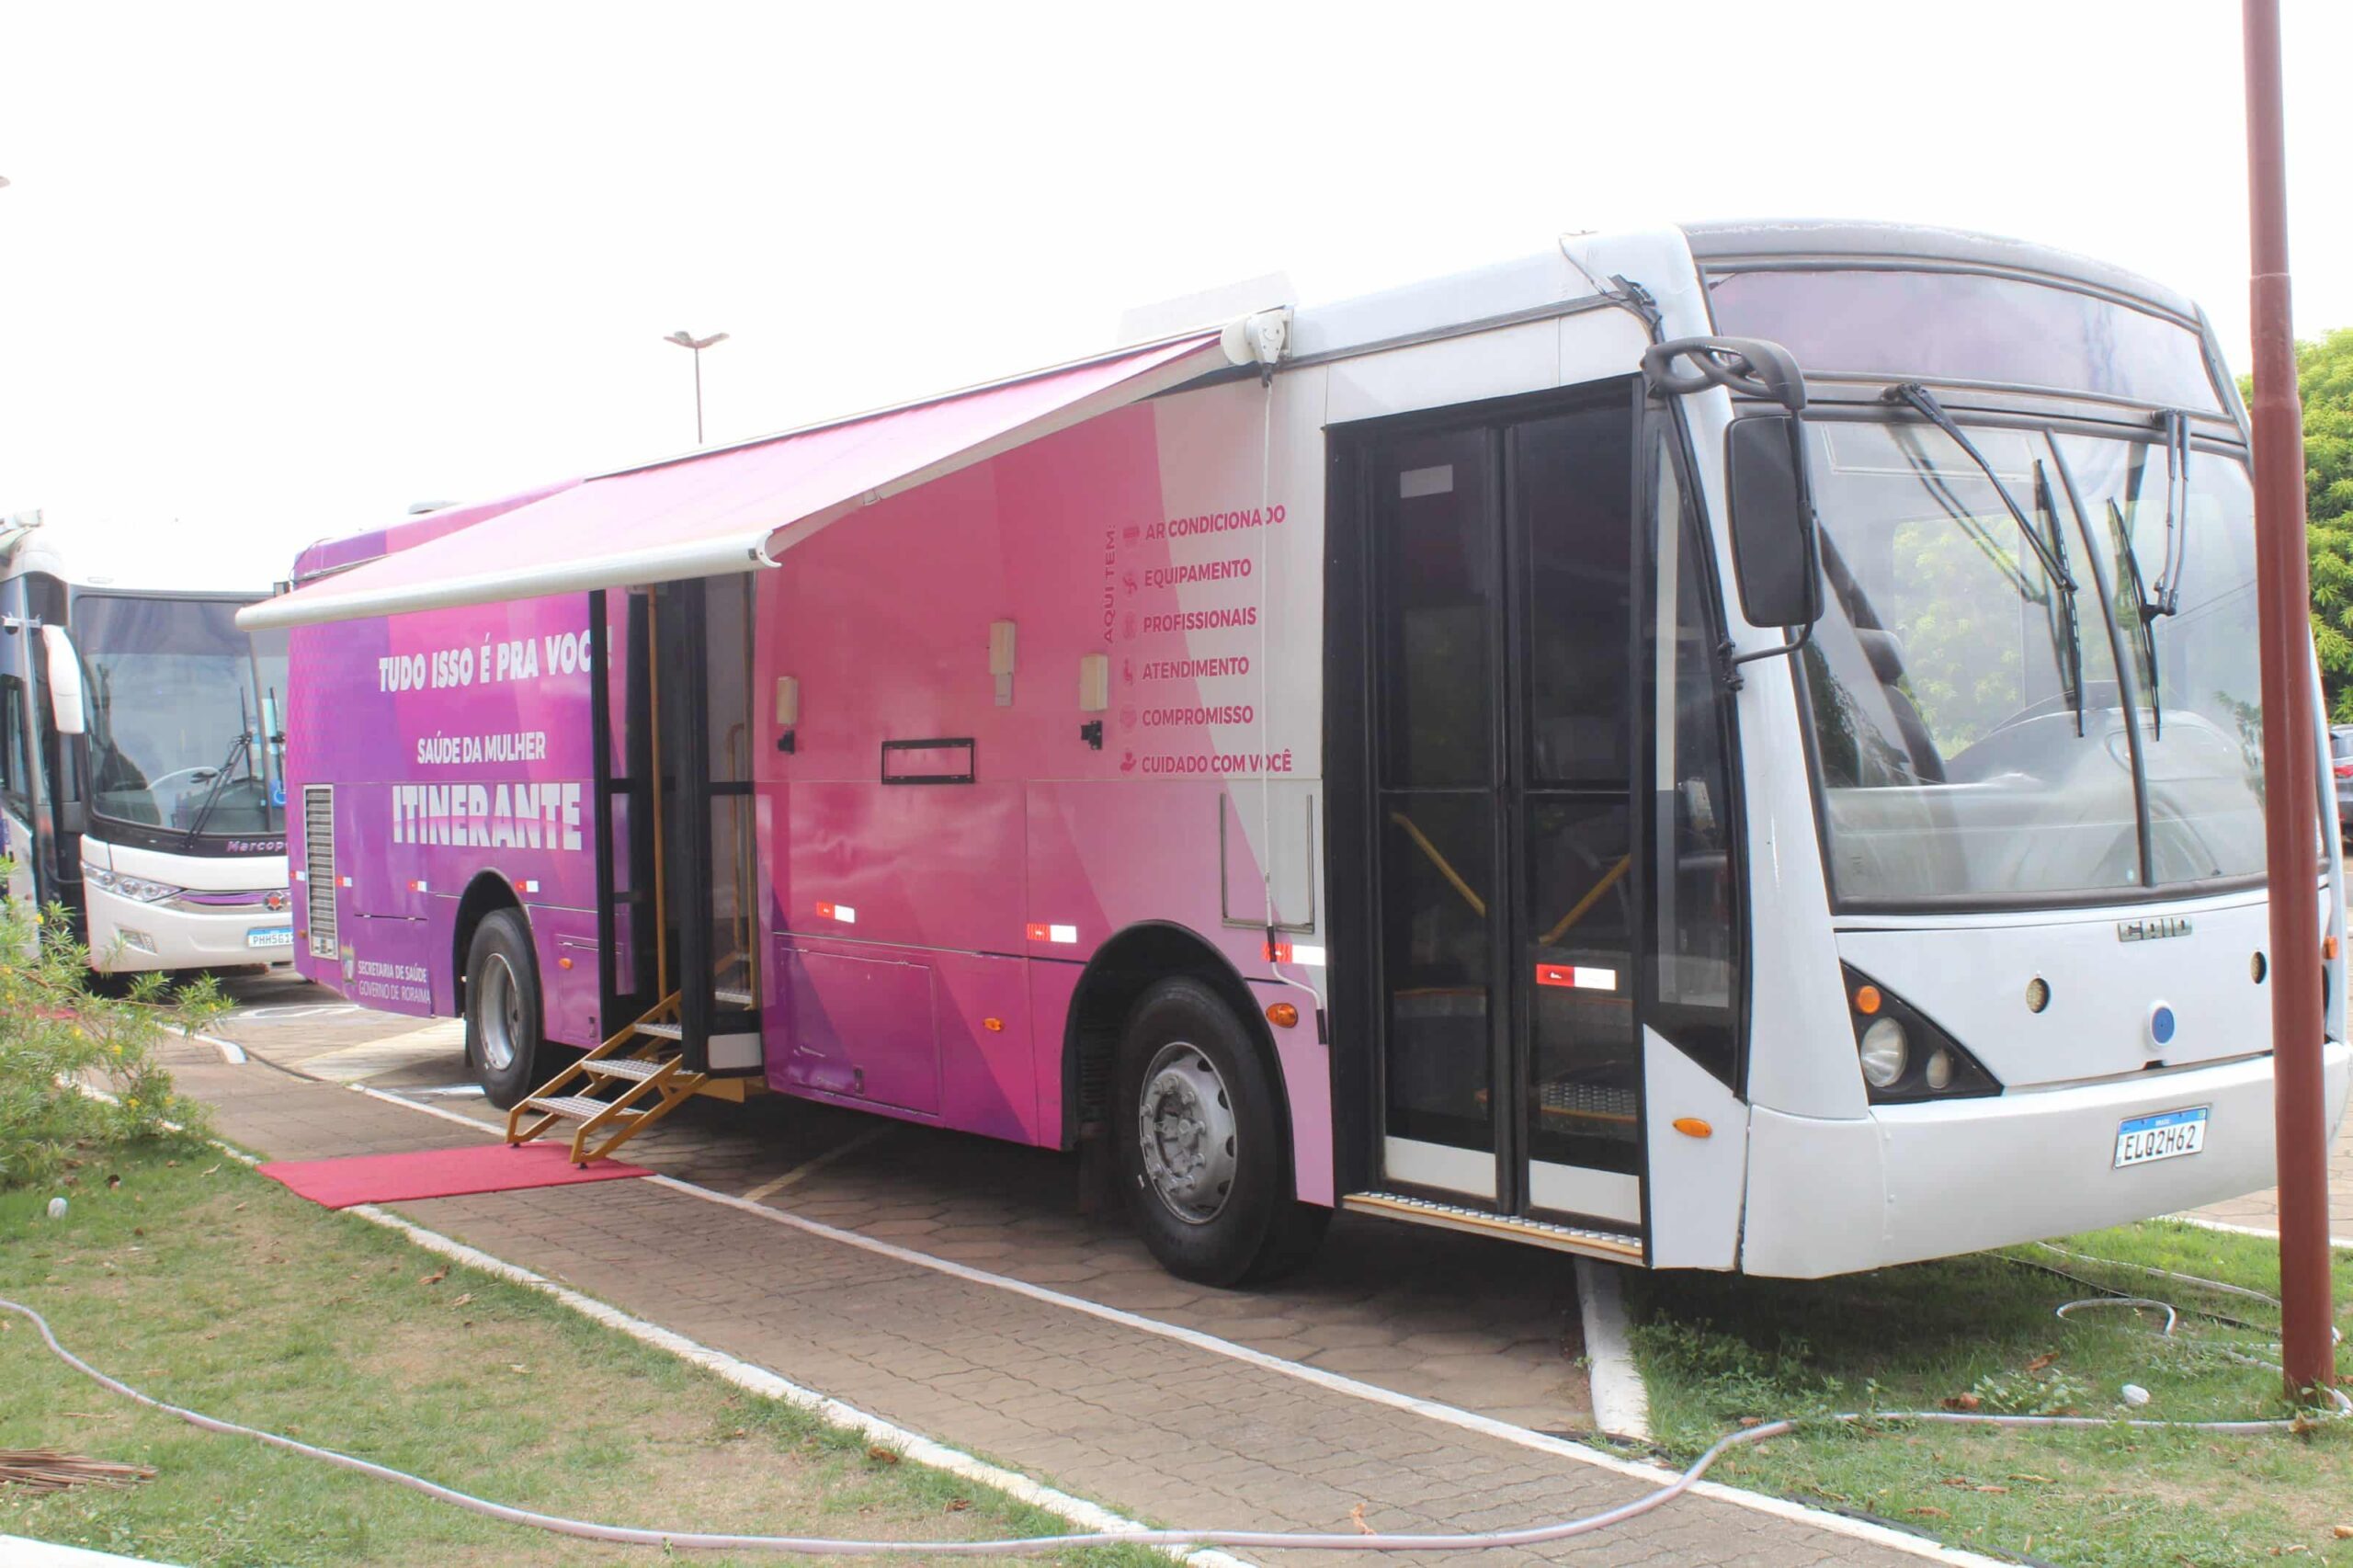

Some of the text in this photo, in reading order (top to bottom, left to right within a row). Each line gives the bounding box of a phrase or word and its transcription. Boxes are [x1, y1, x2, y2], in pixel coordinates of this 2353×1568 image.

[1146, 505, 1286, 540] AR CONDICIONADO
[1144, 559, 1252, 588] EQUIPAMENTO
[1104, 586, 1116, 643] AQUI
[1143, 607, 1257, 633] PROFISSIONAIS
[379, 653, 426, 692] TUDO
[431, 647, 473, 688] ISSO
[480, 632, 491, 684] É
[496, 639, 539, 681] PRA
[1142, 656, 1250, 680] ATENDIMENTO
[1142, 705, 1254, 726] COMPROMISSO
[417, 731, 546, 764] SAÚDE DA MULHER
[1142, 755, 1208, 773] CUIDADO
[1211, 755, 1245, 773] COM
[392, 783, 582, 851] ITINERANTE
[226, 840, 288, 852] Marcop
[2118, 916, 2192, 942] CAIO
[358, 960, 427, 983] SECRETARIA DE SAÚDE
[359, 980, 431, 1004] GOVERNO DE RORAIMA
[2124, 1124, 2196, 1161] ELQ2H62
